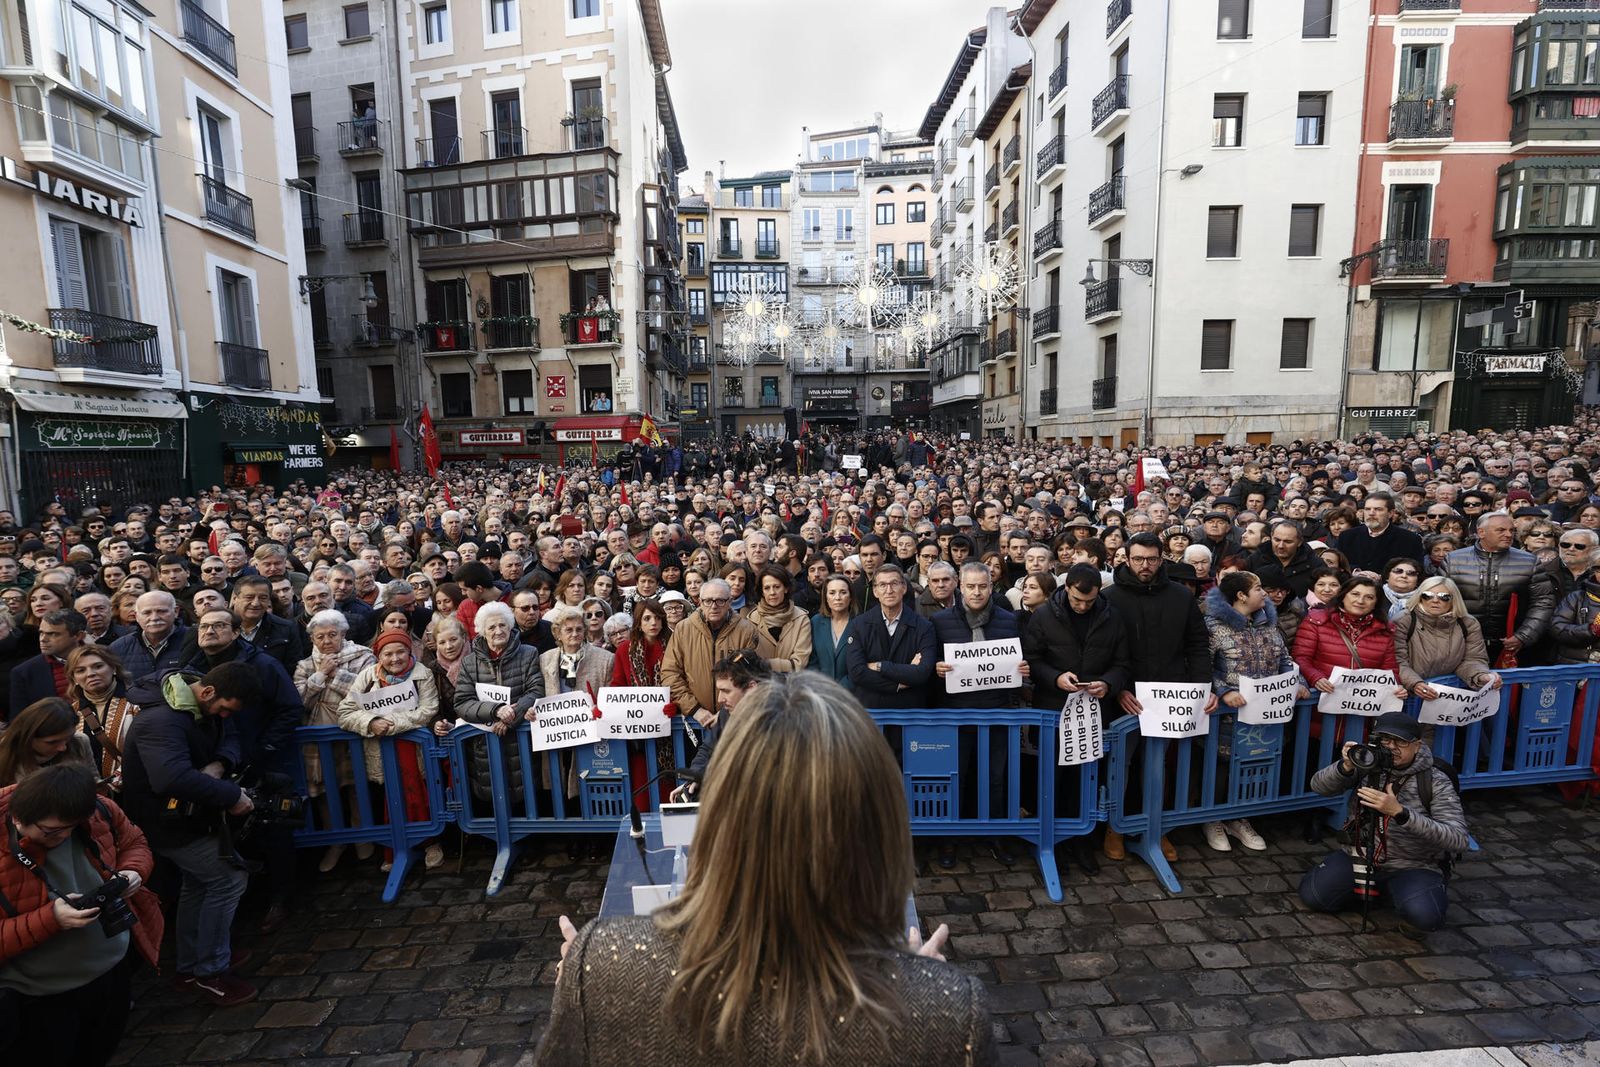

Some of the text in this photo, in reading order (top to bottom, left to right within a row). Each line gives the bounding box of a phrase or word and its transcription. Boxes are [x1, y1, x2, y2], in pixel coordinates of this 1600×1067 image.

[0, 156, 144, 228] LIARIA
[1487, 357, 1542, 371] FARMACIA
[1351, 408, 1417, 418] GUTIERREZ
[73, 426, 116, 442] Sagrario
[468, 432, 514, 442] GUTIERREZ
[241, 450, 285, 462] VIANDAS
[284, 456, 324, 469] FARMERS
[954, 645, 1018, 660] PAMPLONA
[977, 662, 996, 673] NO
[960, 674, 1013, 688] SE VENDE
[1341, 673, 1397, 686] TRAICIÓN
[606, 693, 666, 703] PAMPLONA
[1151, 687, 1206, 700] TRAICIÓN
[1270, 692, 1293, 706] POR
[1352, 688, 1378, 698] POR
[363, 689, 415, 711] BARROLA
[535, 698, 590, 714] MEMORIA,
[1340, 700, 1382, 712] SILLÓN
[626, 709, 644, 719] NO
[1168, 705, 1194, 716] POR
[539, 712, 593, 729] DIGNIDAD,
[1437, 713, 1454, 723] SE
[610, 723, 661, 734] SE VENDE
[1088, 696, 1100, 758] SOE=BILDU
[1161, 720, 1197, 733] SILLÓN
[546, 728, 587, 743] JUSTICIA
